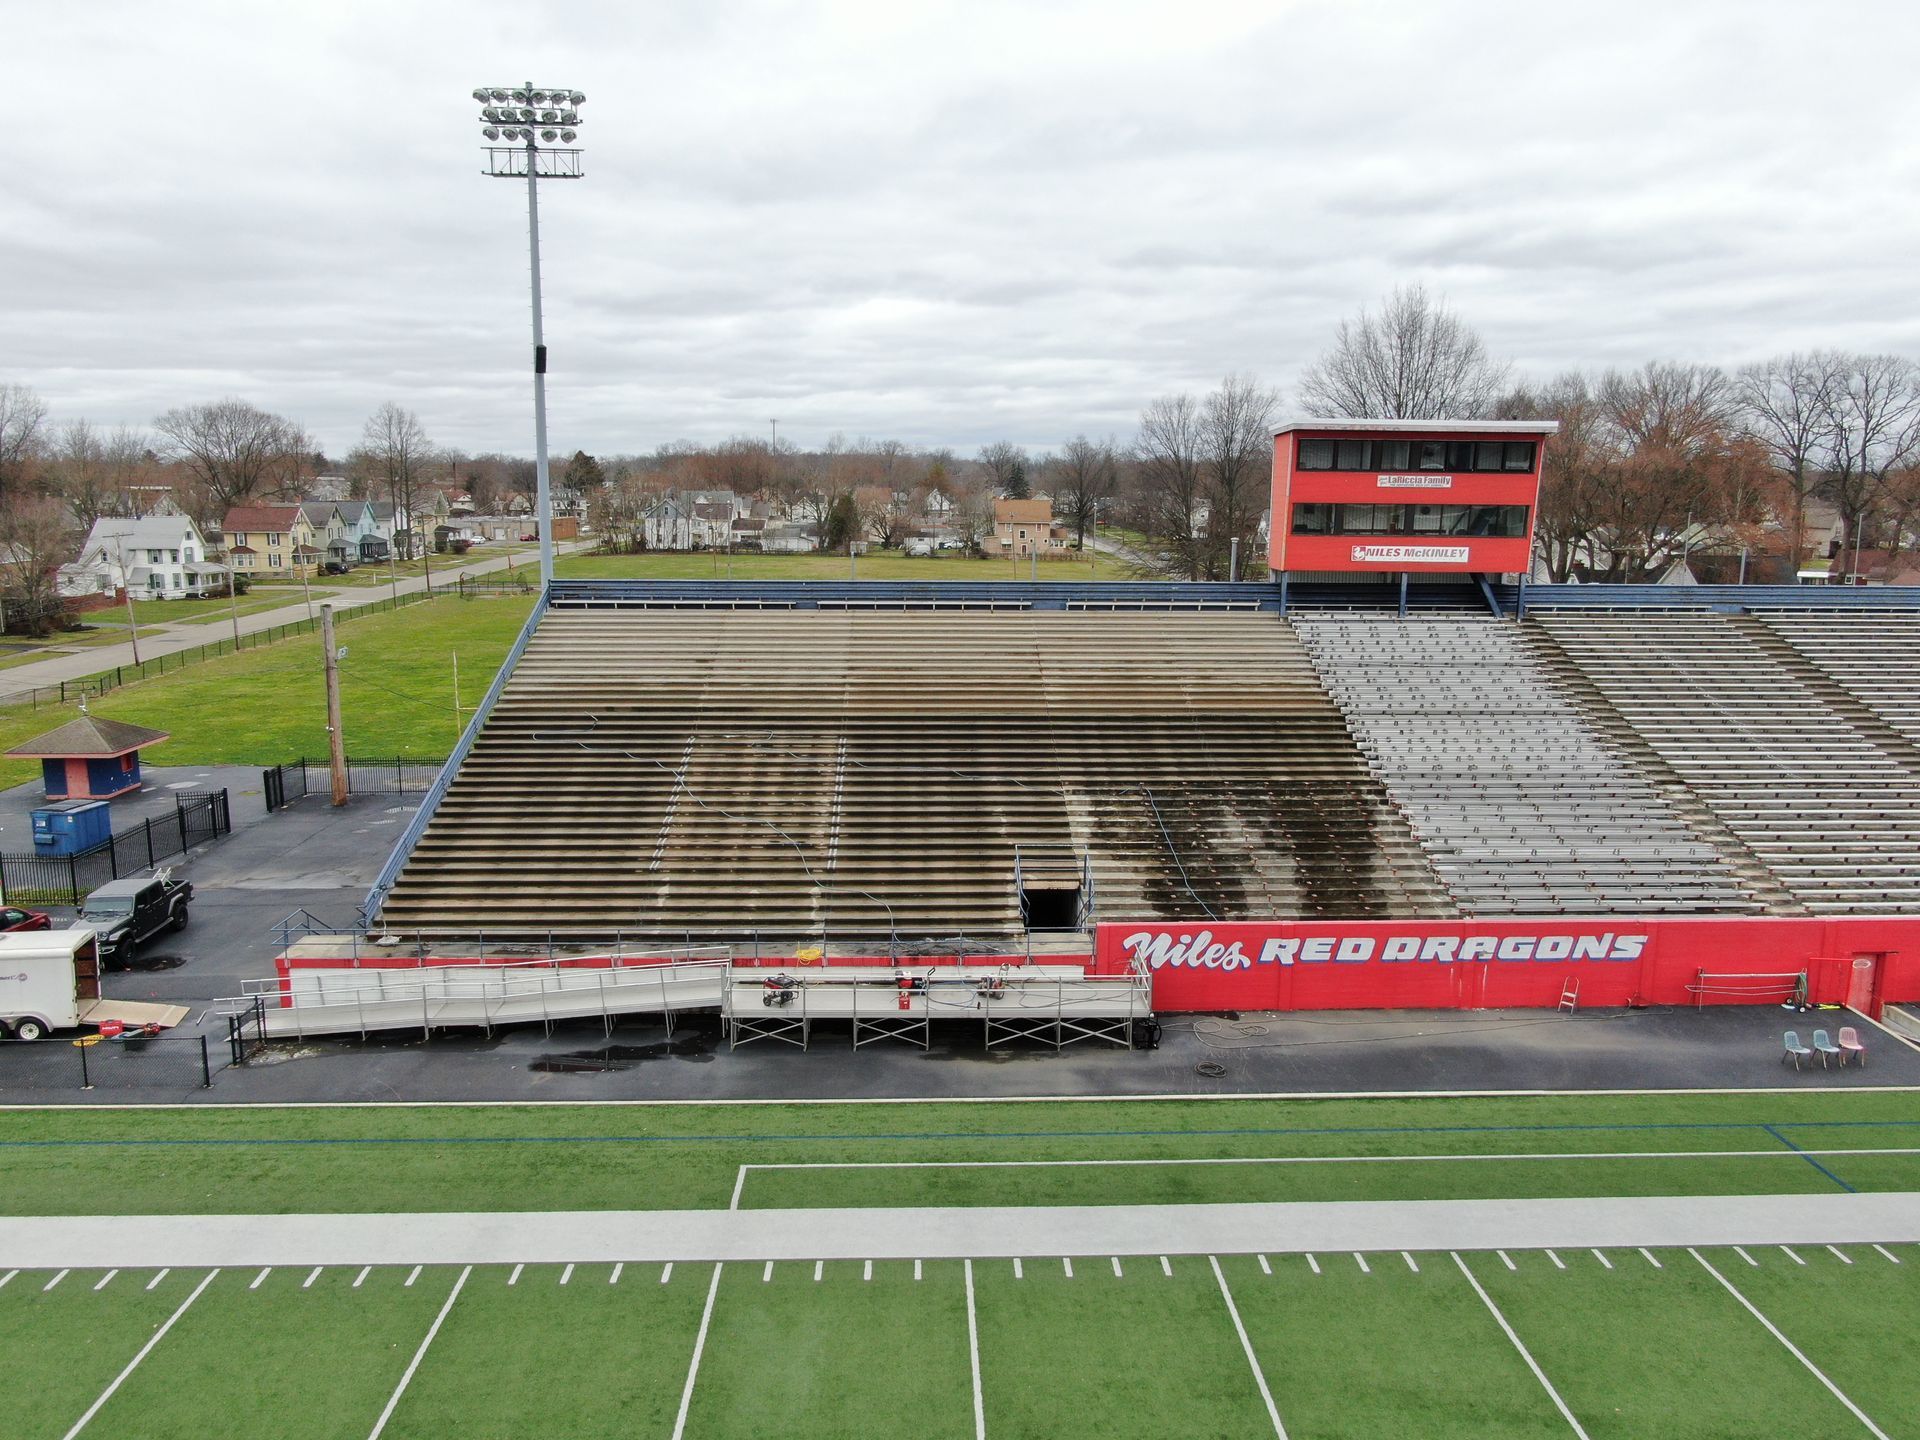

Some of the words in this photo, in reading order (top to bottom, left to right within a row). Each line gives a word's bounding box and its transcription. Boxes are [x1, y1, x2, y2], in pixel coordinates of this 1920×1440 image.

[1388, 476, 1423, 484] LaRiccia
[1424, 476, 1451, 485] Family
[1365, 548, 1401, 557] NILES
[1403, 548, 1466, 558] McKINLEY
[1122, 930, 1252, 971] Niles
[1257, 937, 1377, 966] RED
[1381, 933, 1649, 963] DRAGONS
